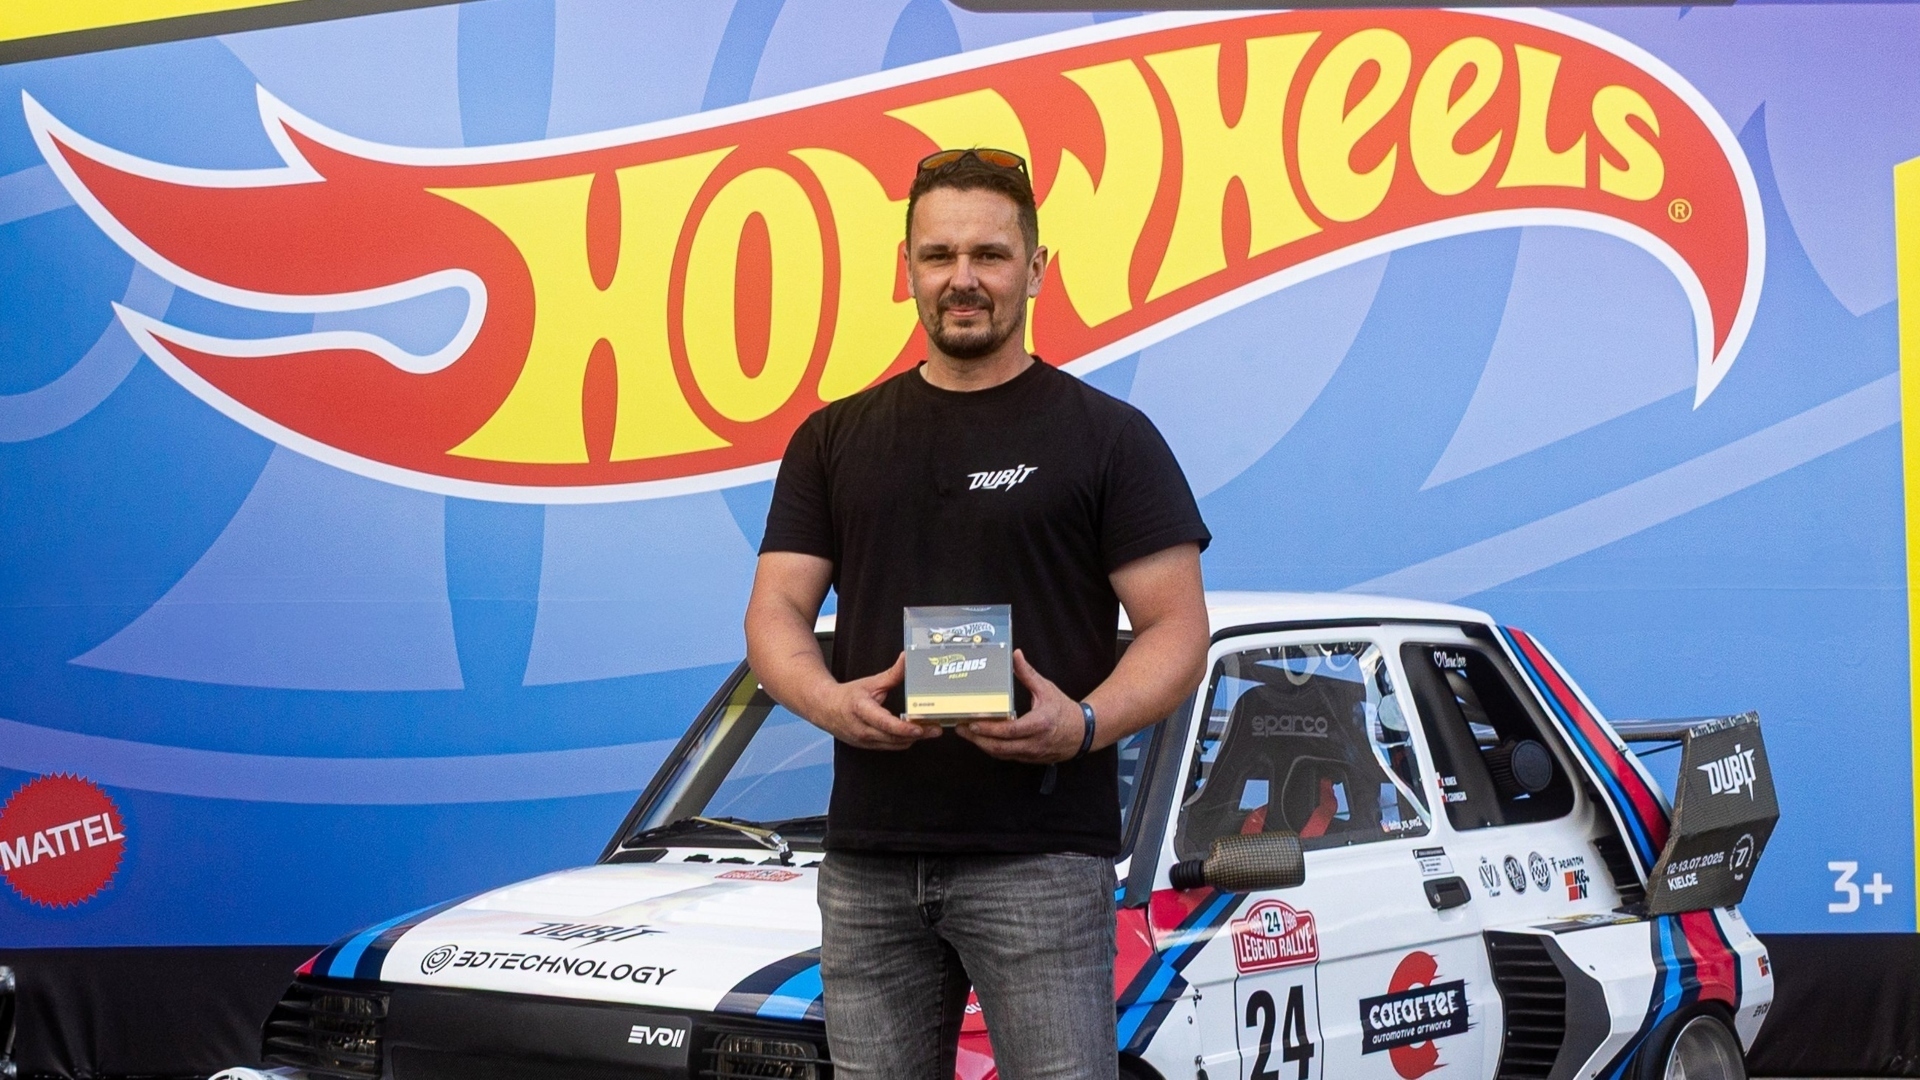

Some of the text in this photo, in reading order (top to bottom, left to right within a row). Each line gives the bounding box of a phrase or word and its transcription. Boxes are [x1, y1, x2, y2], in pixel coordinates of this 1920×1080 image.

[933, 657, 987, 676] LEGENDS
[1252, 715, 1328, 737] sparco
[0, 812, 125, 871] MATTEL
[1666, 851, 1725, 875] 12-13.07.2025
[1667, 872, 1699, 891] KIELCE
[1827, 861, 1893, 913] 3+
[1264, 911, 1280, 932] 24
[1236, 931, 1278, 963] LEGEND
[1279, 920, 1315, 957] RALLYE
[453, 951, 678, 985] 3DTECHNOLOGY
[1245, 984, 1315, 1080] 24
[1417, 1019, 1452, 1037] artworks
